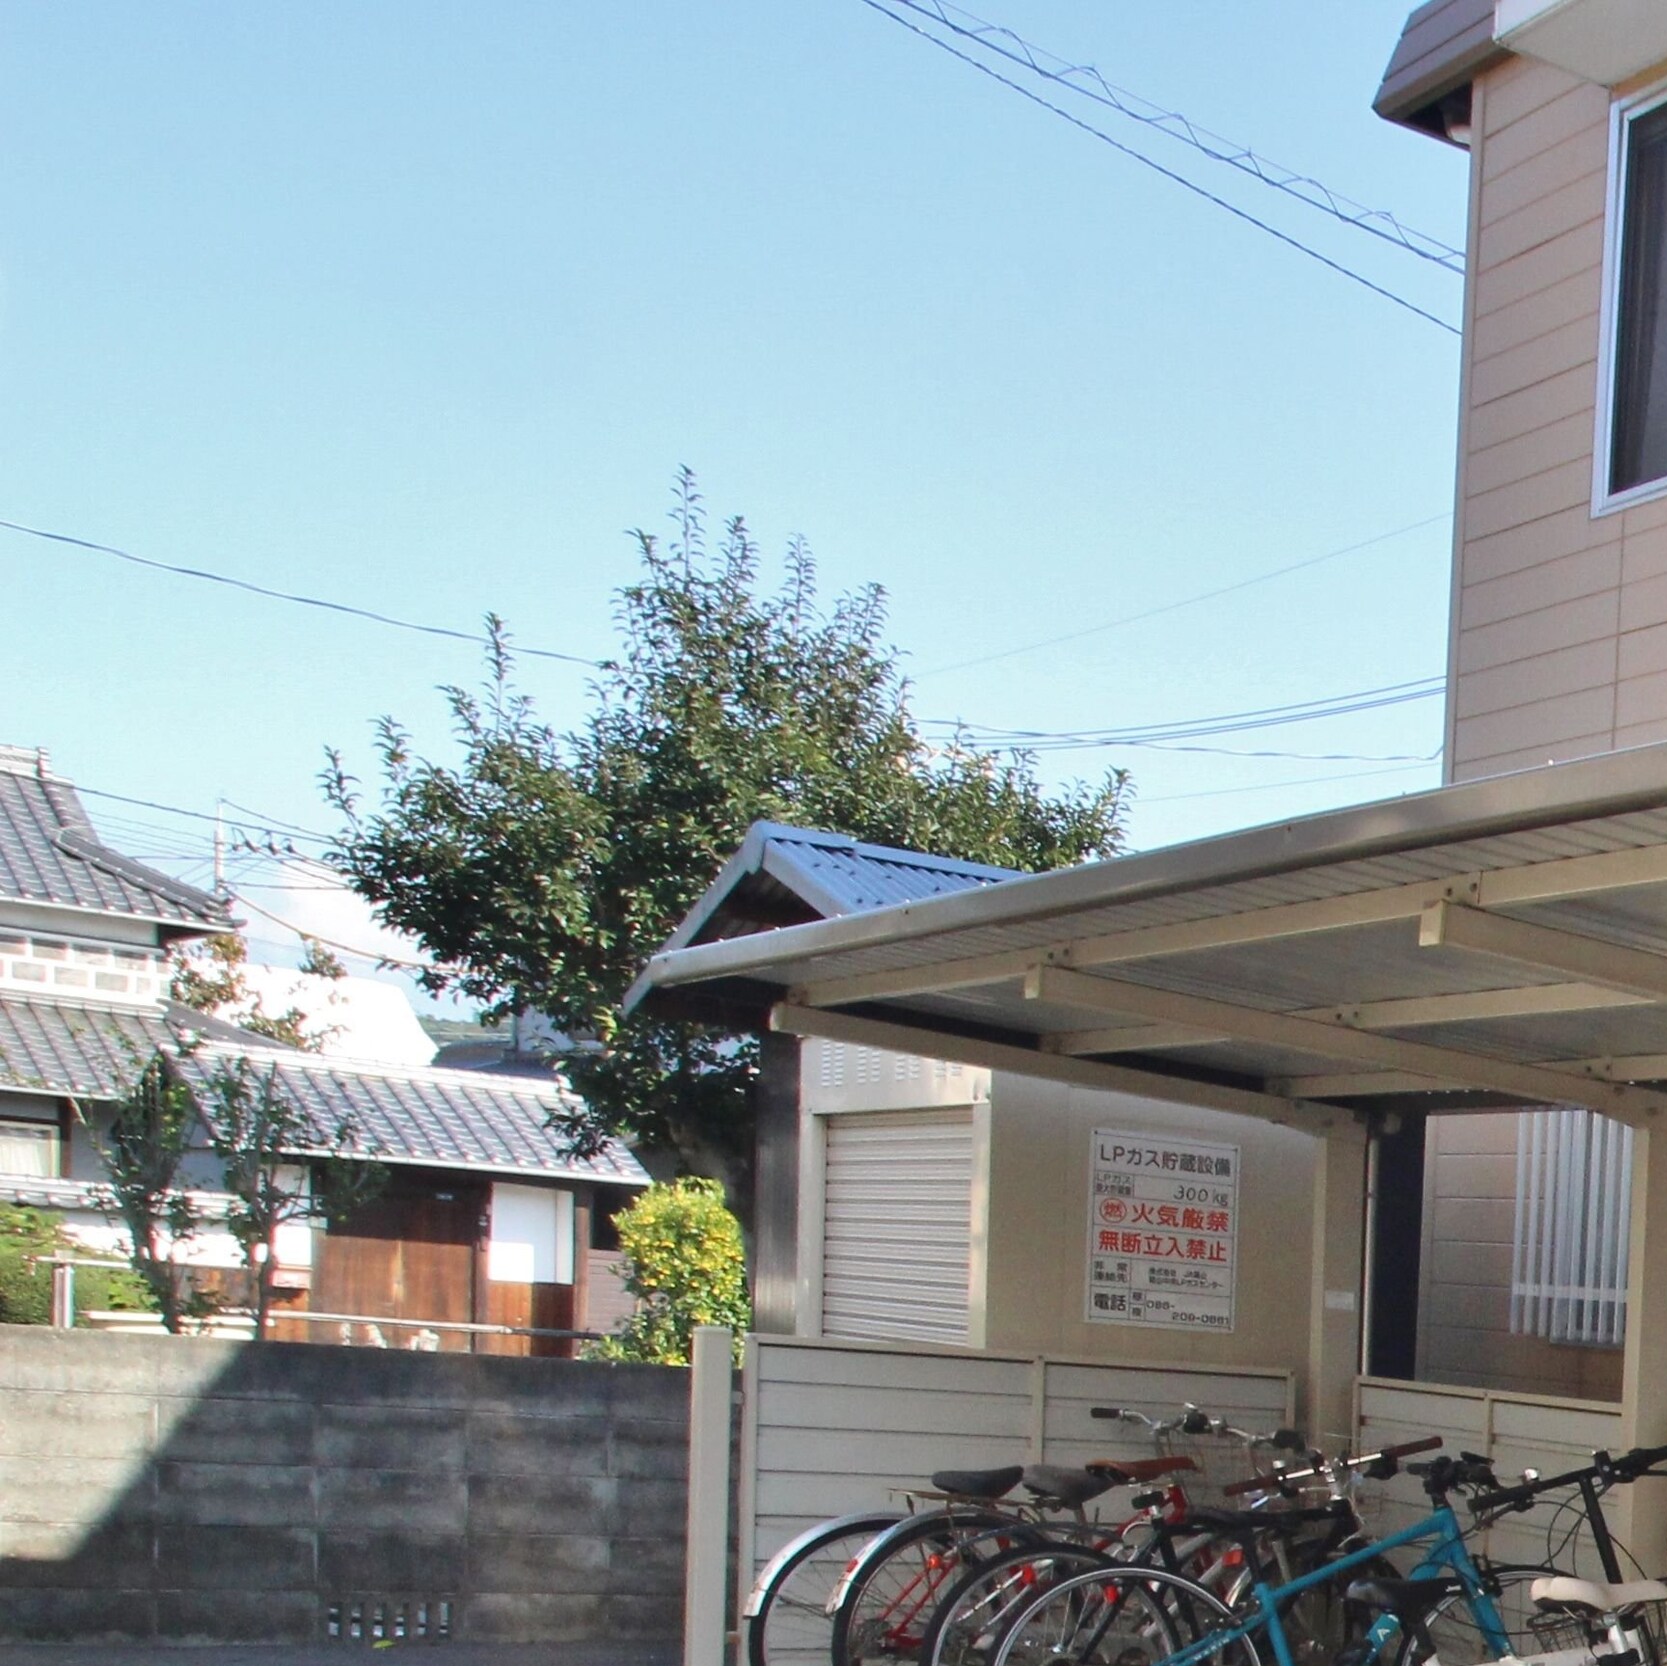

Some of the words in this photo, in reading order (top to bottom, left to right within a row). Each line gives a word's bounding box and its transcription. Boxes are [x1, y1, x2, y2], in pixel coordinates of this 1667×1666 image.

[1100, 1143, 1231, 1177] LPガス貯蔵設備
[1096, 1172, 1131, 1185] LPガス
[1173, 1184, 1209, 1203] 300
[1212, 1188, 1229, 1207] kg
[1131, 1202, 1230, 1233] 火気厳禁
[1098, 1229, 1228, 1263] 無断立入禁止
[1094, 1292, 1127, 1312] 電話
